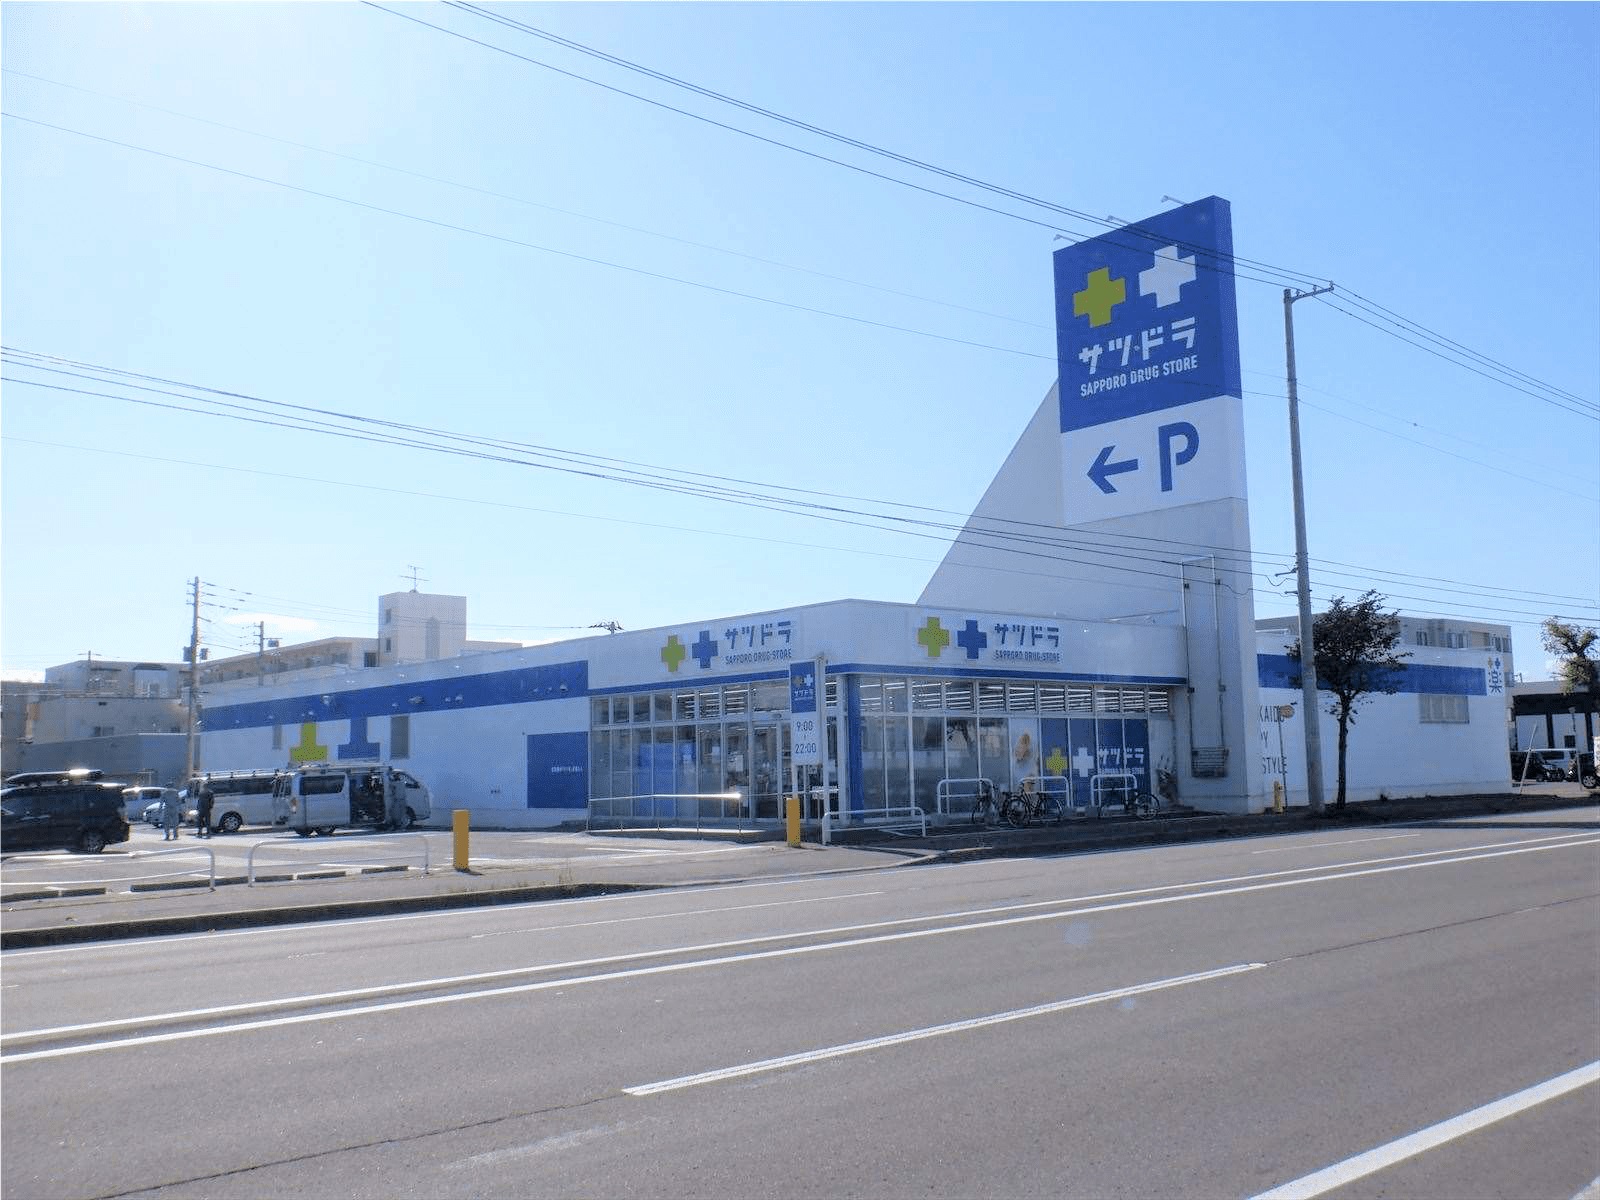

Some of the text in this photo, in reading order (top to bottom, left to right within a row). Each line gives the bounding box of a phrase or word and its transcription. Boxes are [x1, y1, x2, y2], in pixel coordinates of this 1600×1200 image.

[1080, 354, 1198, 397] SAPPORO DRUG STORE
[1158, 421, 1200, 492] P
[725, 621, 791, 649] サツドラ
[994, 624, 1059, 647] サツドラ
[725, 653, 753, 665] SAPPORO
[772, 648, 792, 660] STORE
[995, 650, 1023, 660] SAPPORO
[796, 720, 813, 731] 9:00
[795, 742, 817, 754] 22:00
